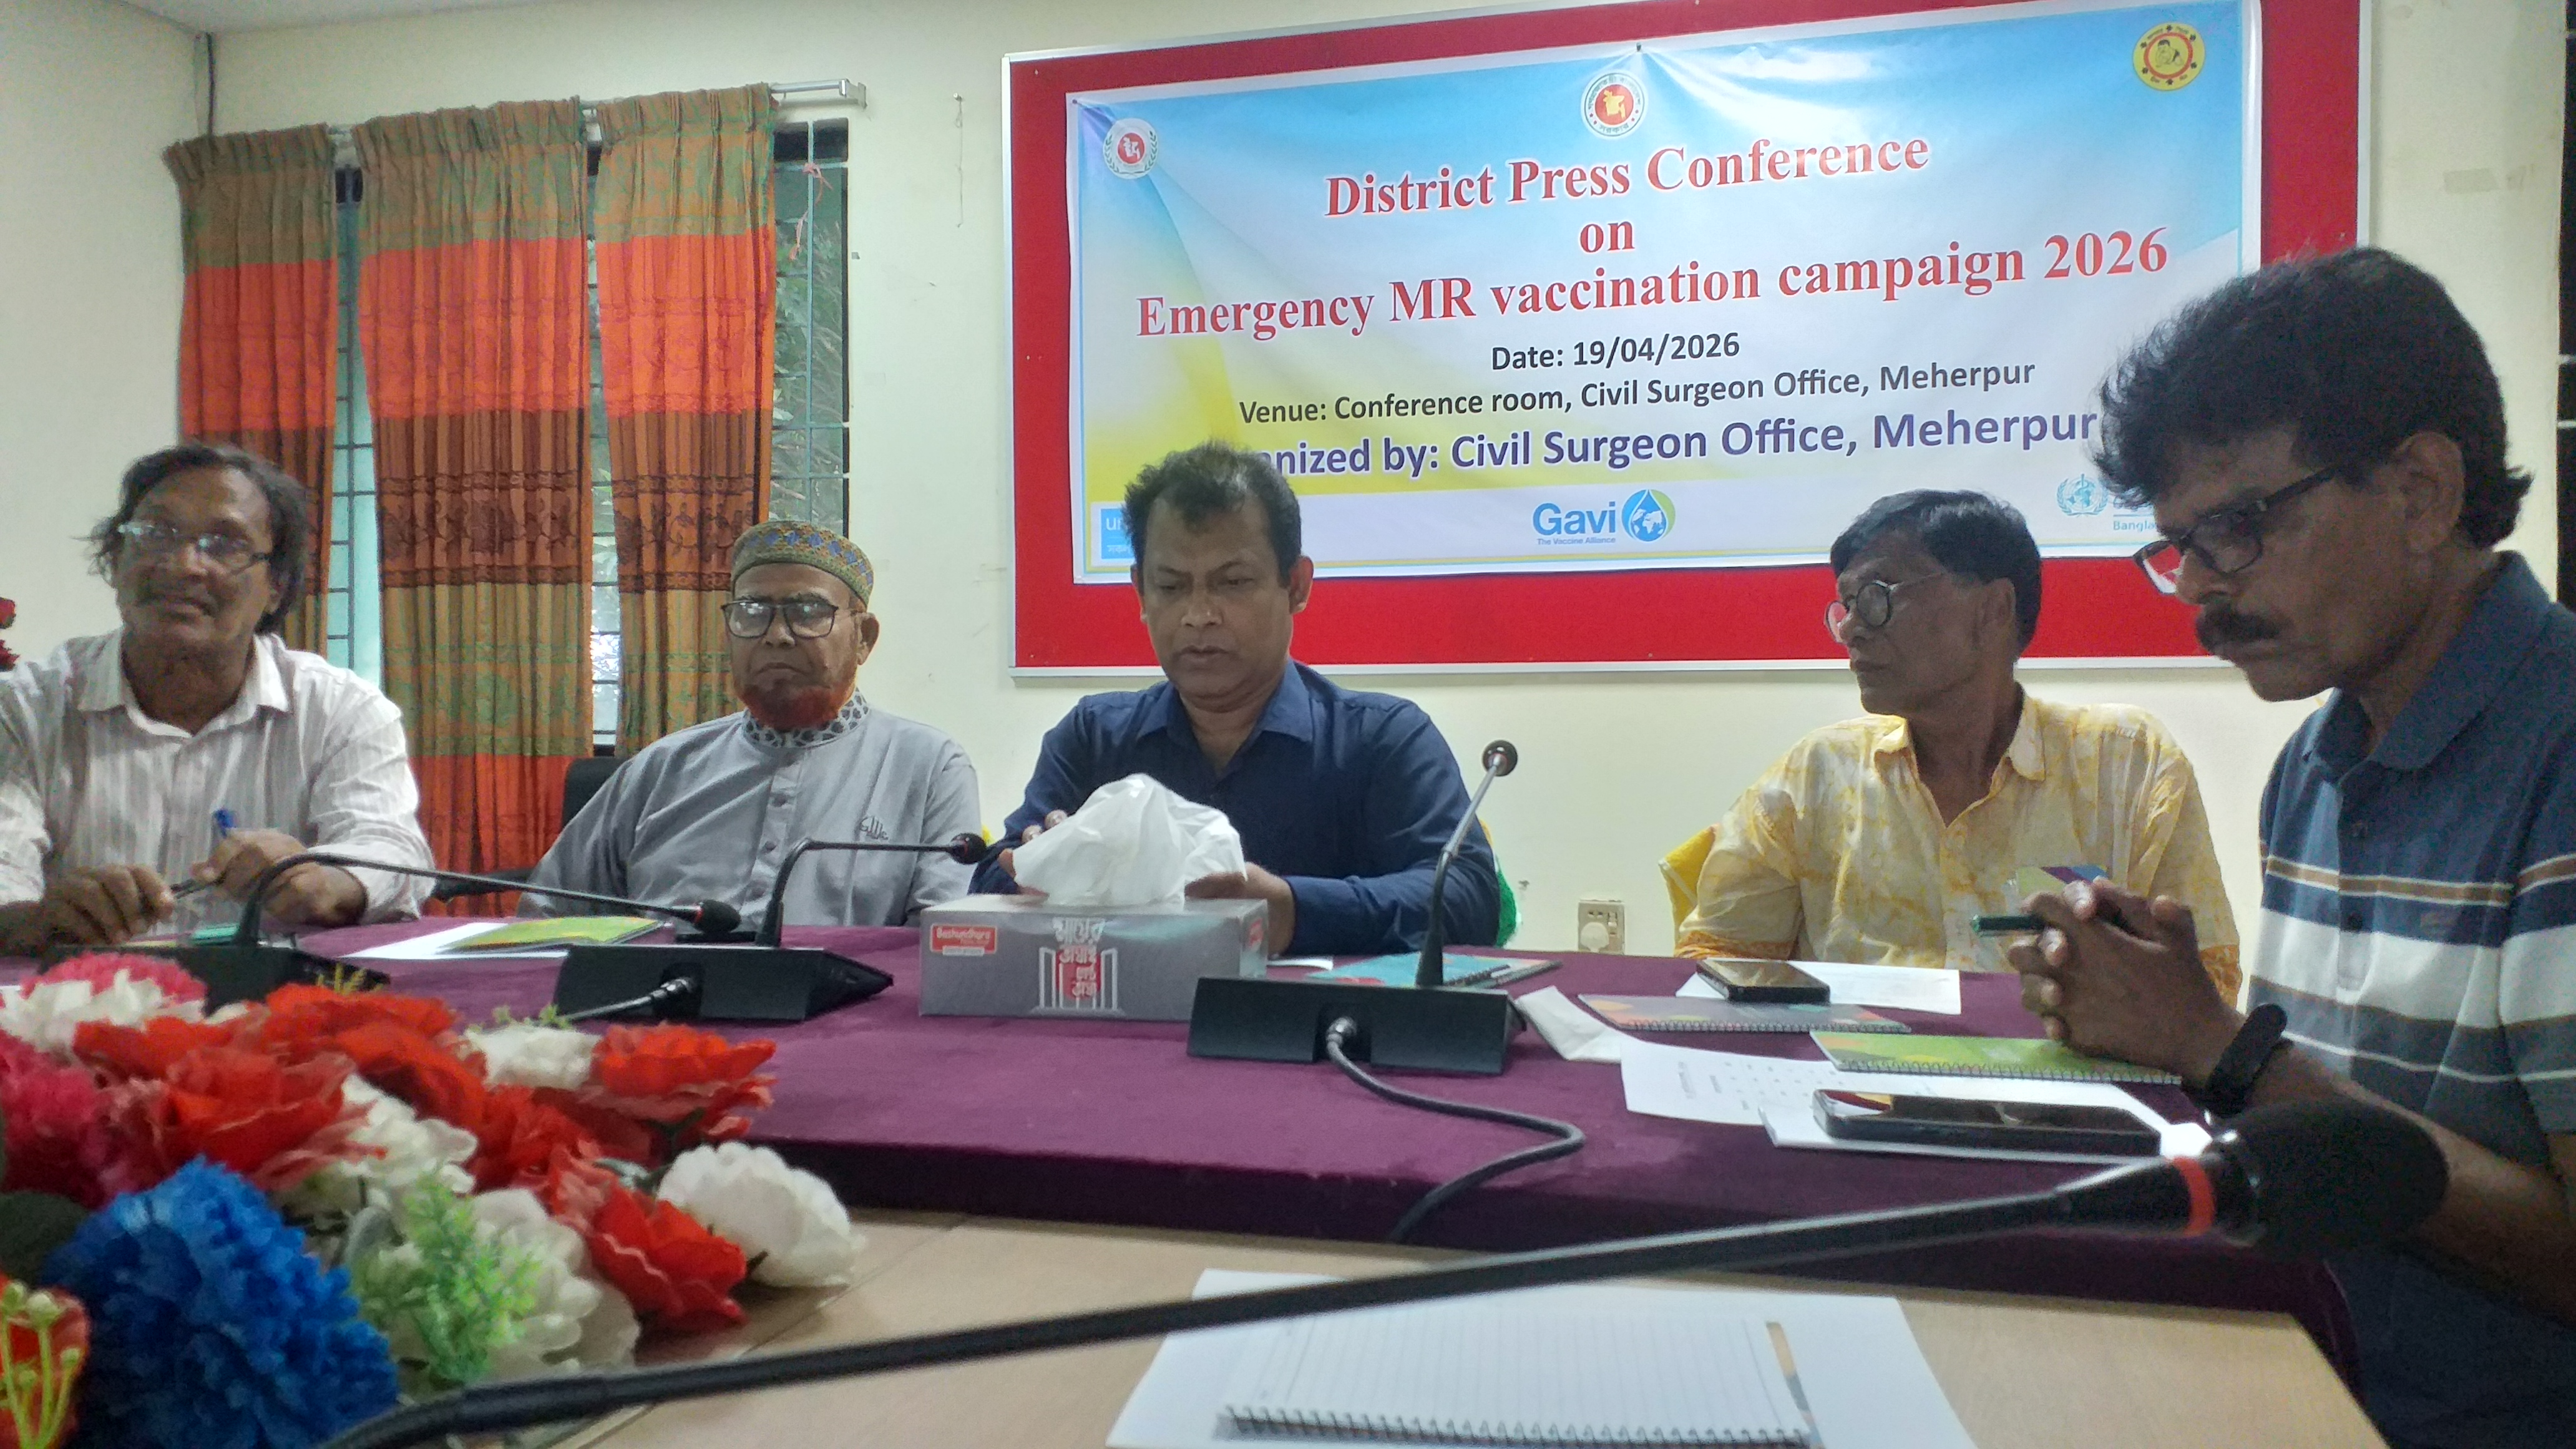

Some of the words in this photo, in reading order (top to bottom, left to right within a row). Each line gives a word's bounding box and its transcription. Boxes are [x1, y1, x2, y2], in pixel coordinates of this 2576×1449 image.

[1324, 167, 1494, 216] District
[1508, 161, 1630, 202] Press
[1647, 139, 1928, 190] Conference
[1580, 221, 1635, 253] on
[1137, 295, 1375, 341] Emergency
[1388, 278, 1476, 321] MR
[1490, 260, 1761, 315] vaccination
[1778, 241, 2026, 301] campaign
[2044, 227, 2167, 278] 2026
[1492, 346, 1563, 370] Date:
[1574, 332, 1740, 369] 19/04/2026
[1239, 401, 1326, 424] Venue:
[1335, 393, 1483, 419] Conference
[1492, 391, 1571, 413] room,
[1581, 379, 1637, 407] Civil
[1647, 379, 1764, 407] Surgeon
[1774, 369, 1869, 397] Office,
[1881, 362, 2036, 392] Meherpur
[1261, 438, 1370, 475] nized
[1384, 437, 1438, 478] by:
[1451, 431, 1530, 467] Civil
[1544, 431, 1706, 469] Surgeon
[1722, 417, 1856, 457] Office,
[1874, 409, 2097, 451] Meherpur
[1533, 501, 1616, 535] Gavi
